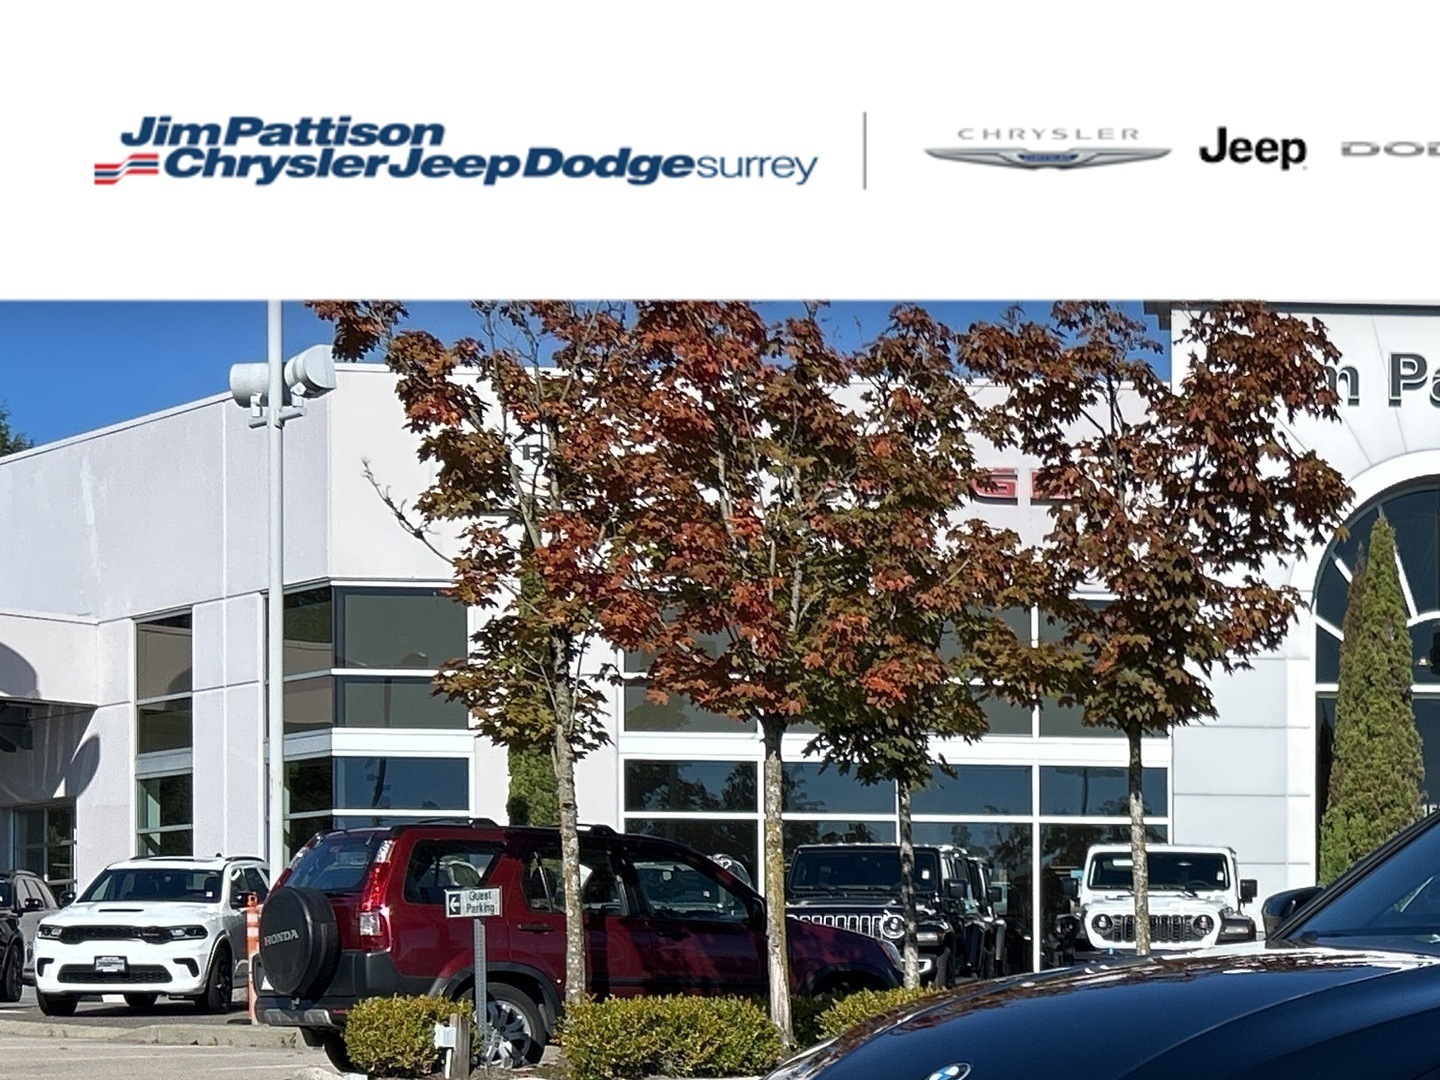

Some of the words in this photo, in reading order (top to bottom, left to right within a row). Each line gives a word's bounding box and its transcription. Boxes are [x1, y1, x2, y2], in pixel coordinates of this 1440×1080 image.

[469, 890, 492, 901] Guest
[466, 902, 495, 915] Parking
[264, 929, 299, 946] HONDA
